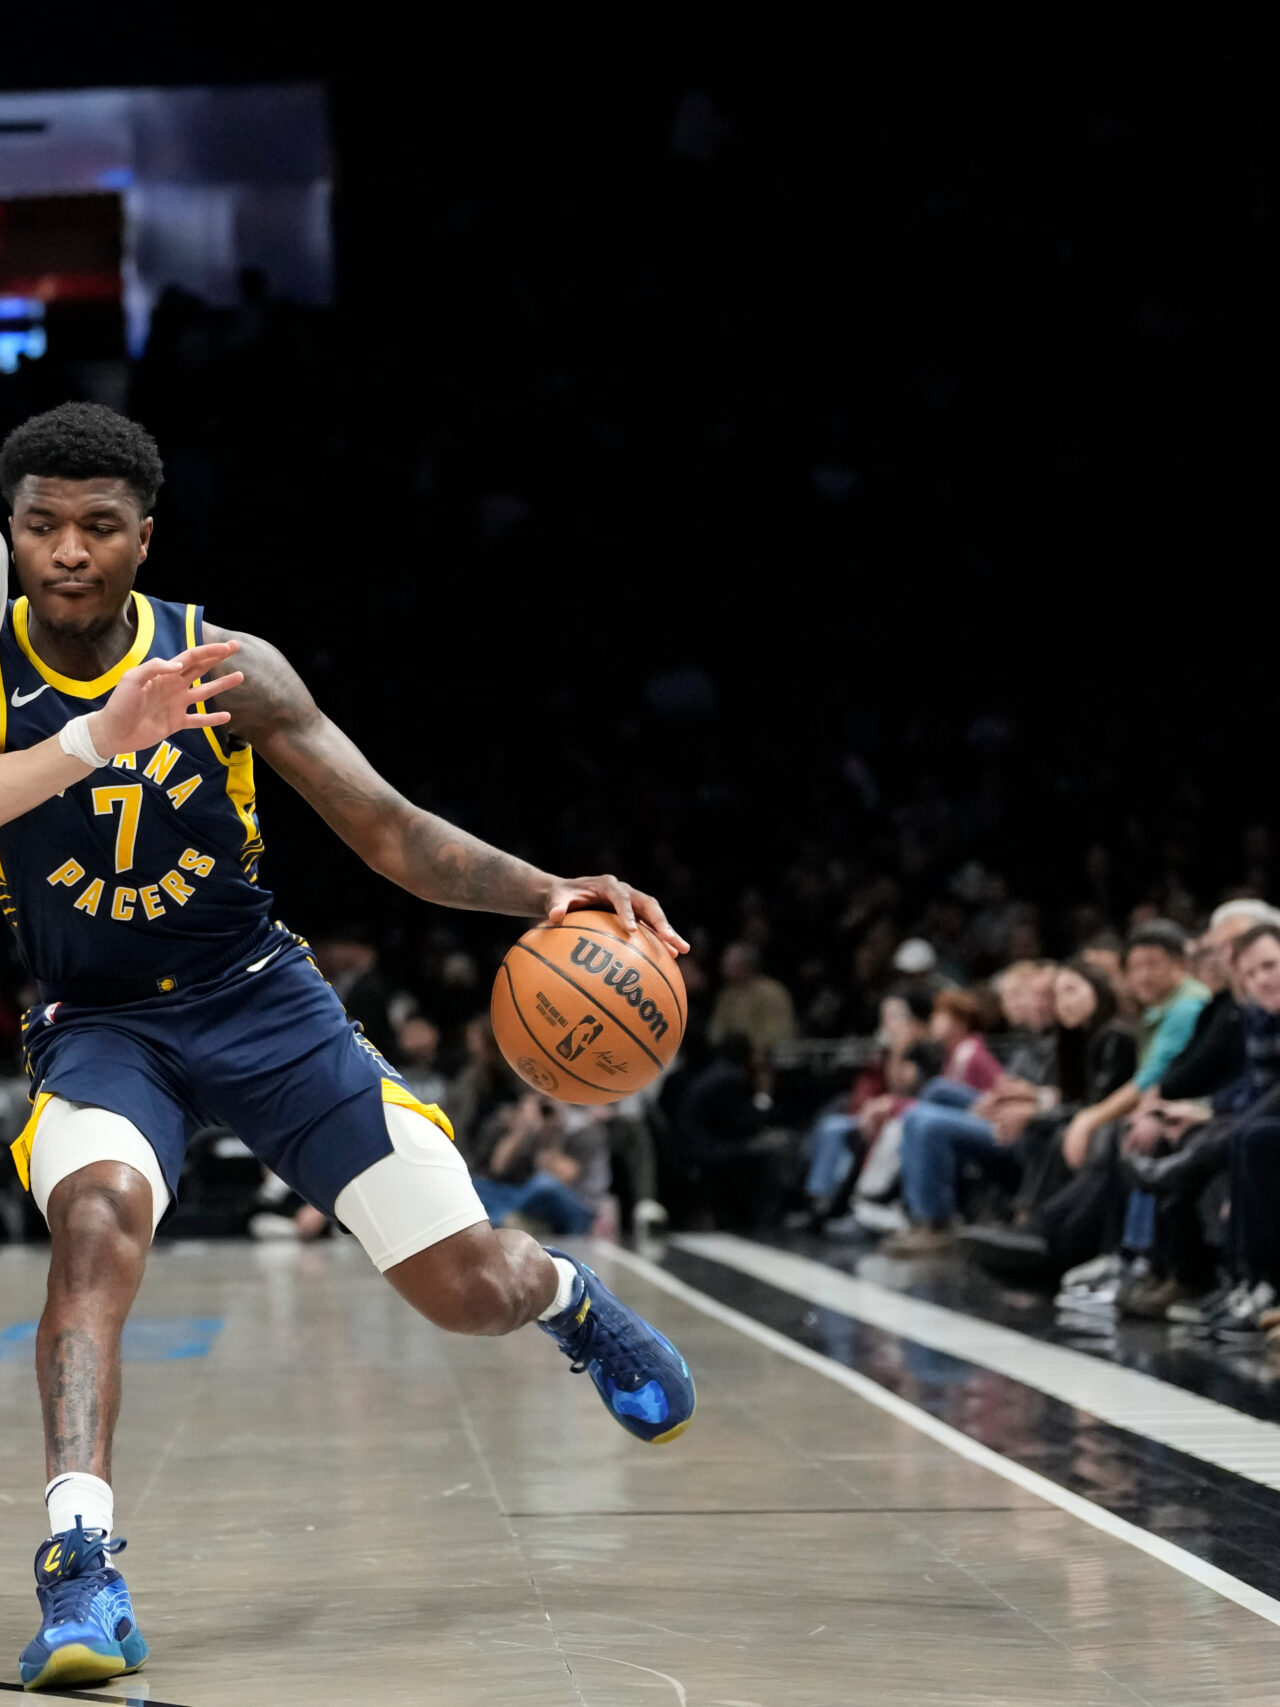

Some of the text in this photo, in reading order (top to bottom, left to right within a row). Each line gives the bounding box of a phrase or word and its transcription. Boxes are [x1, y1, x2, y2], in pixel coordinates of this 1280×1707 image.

[92, 784, 143, 874] 7
[46, 847, 216, 921] PACERS
[570, 936, 669, 1044] Wilson
